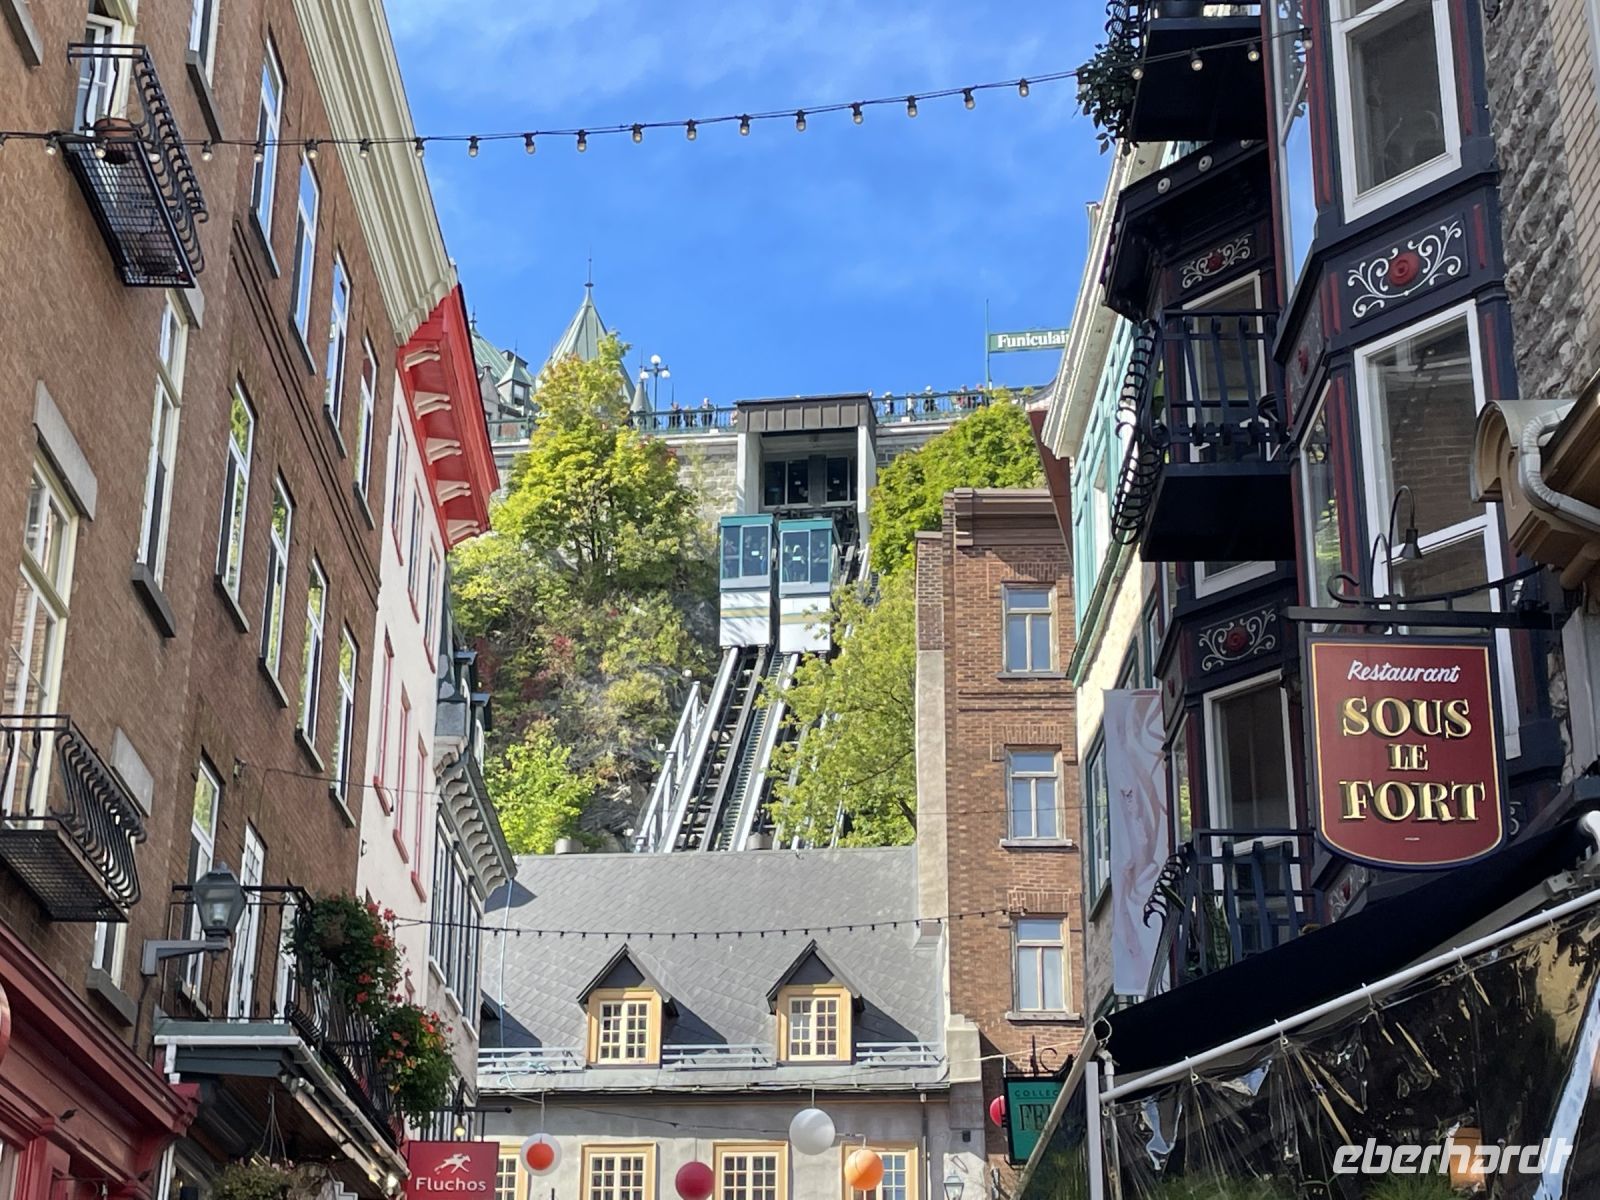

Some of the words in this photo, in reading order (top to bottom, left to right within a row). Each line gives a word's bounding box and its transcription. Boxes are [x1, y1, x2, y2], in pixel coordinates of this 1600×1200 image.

[1347, 659, 1461, 683] Restaurant
[1341, 695, 1472, 739] SOUS
[1388, 743, 1429, 772] LE
[1338, 780, 1486, 822] FORT
[415, 1177, 487, 1192] Fluchos
